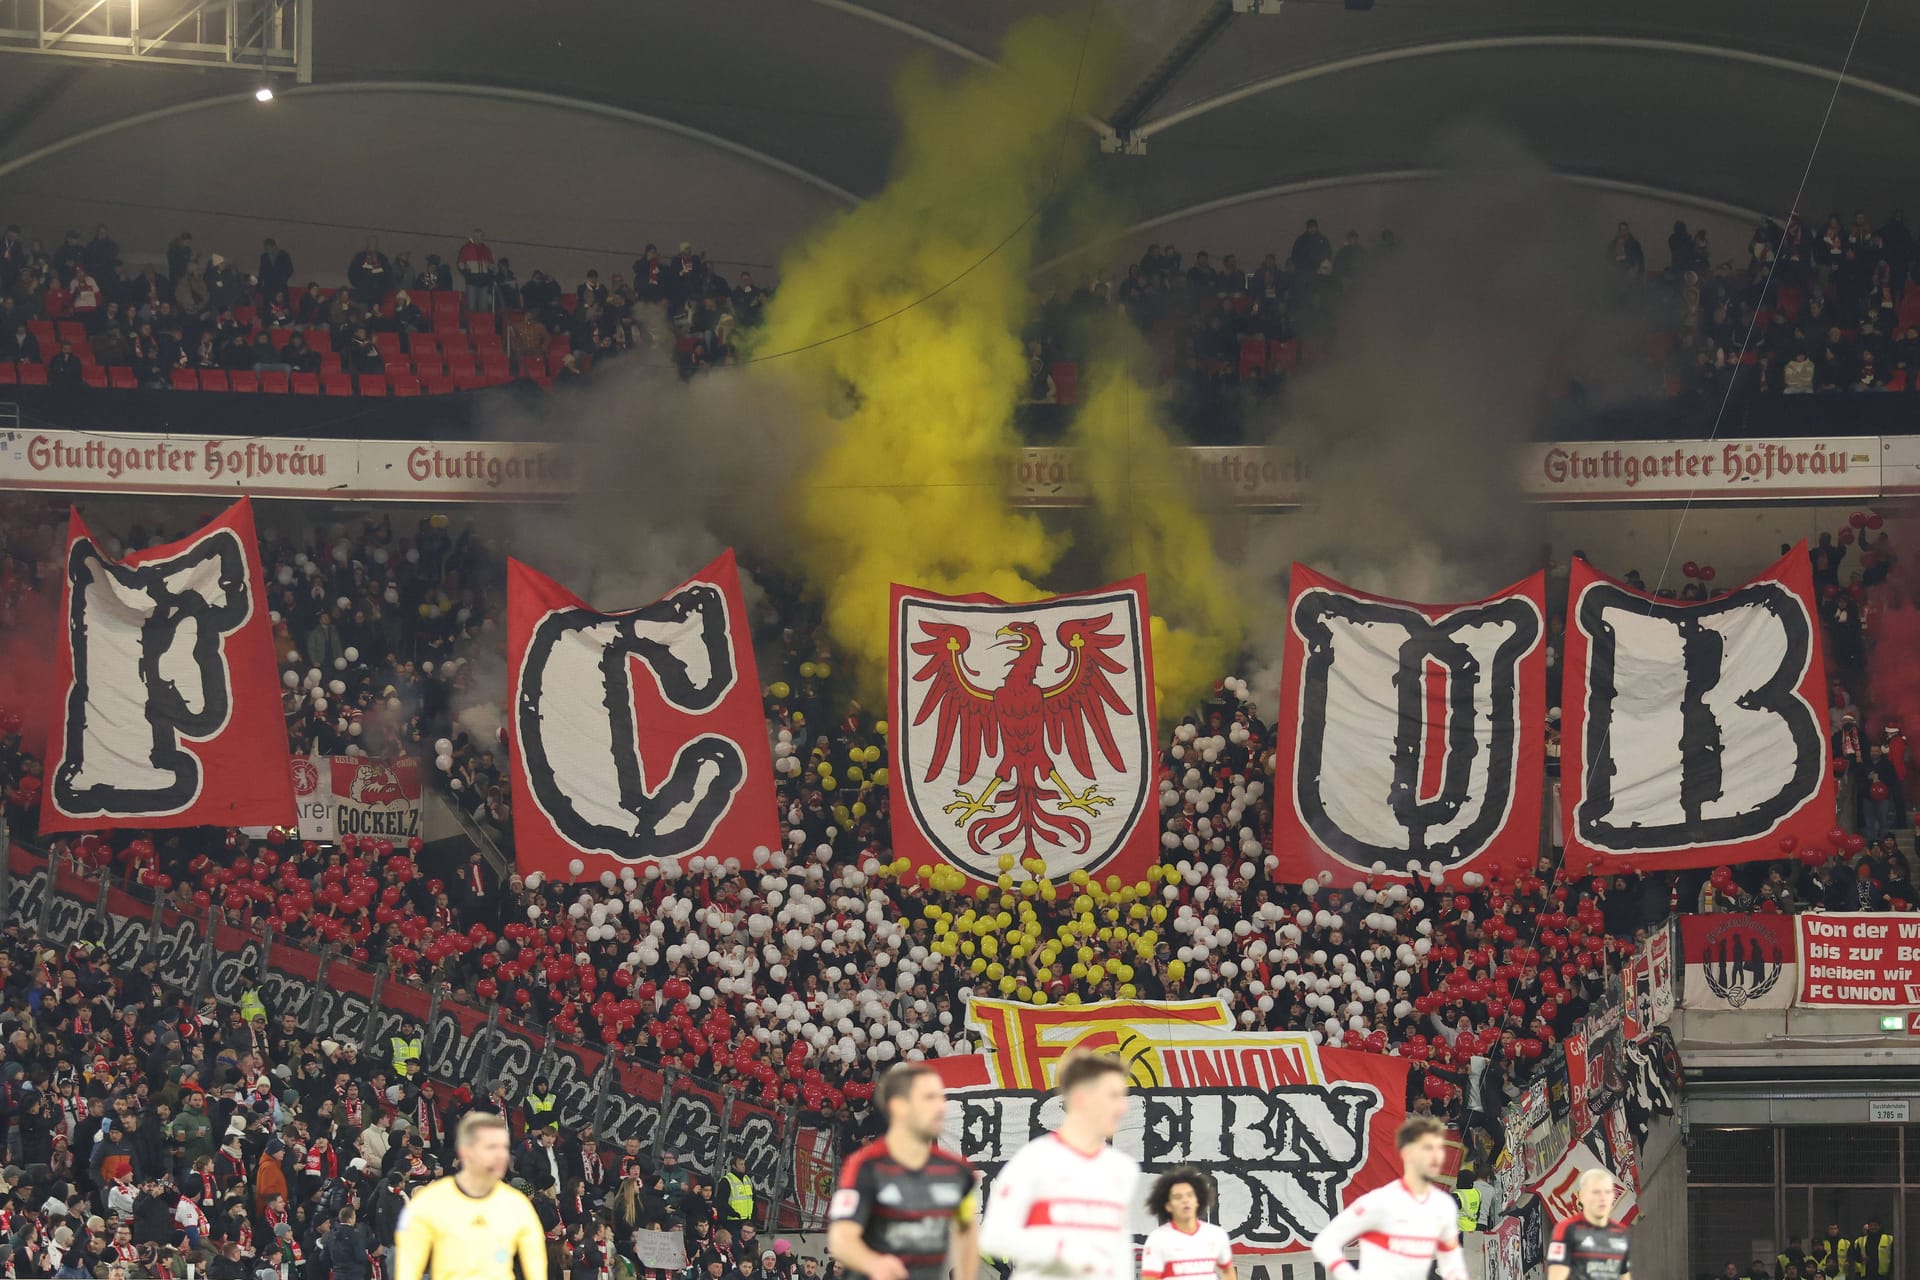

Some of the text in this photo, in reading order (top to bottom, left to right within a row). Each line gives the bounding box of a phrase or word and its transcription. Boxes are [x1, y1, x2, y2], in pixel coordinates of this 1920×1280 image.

[27, 434, 326, 480] Stuttgarter Hofbräu
[407, 446, 562, 488] Stuttgart
[1544, 443, 1848, 487] Stuttgarter Hofbräu
[338, 804, 419, 837] GOCKELZ
[1808, 921, 1847, 938] Von
[1853, 923, 1888, 939] der
[1810, 944, 1840, 960] bis
[1848, 947, 1883, 961] zur
[1810, 965, 1913, 981] bleiben wir
[1810, 985, 1896, 1001] FC UNION
[1163, 1047, 1307, 1088] UNION
